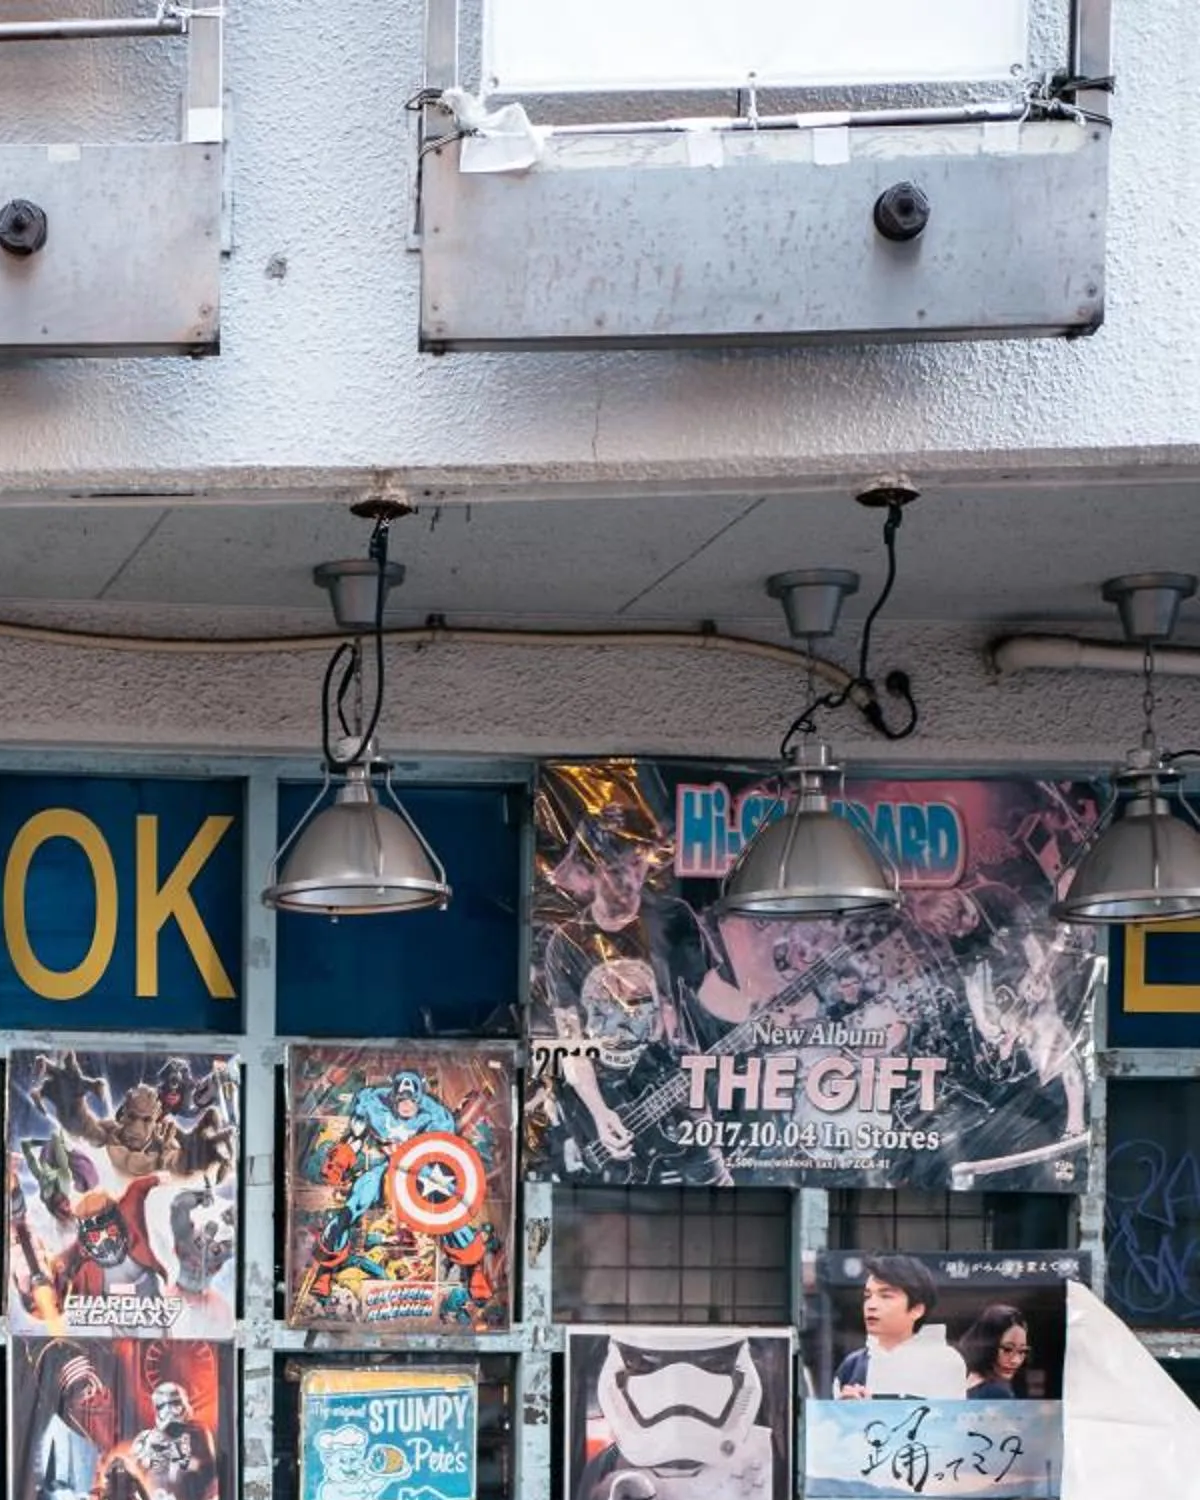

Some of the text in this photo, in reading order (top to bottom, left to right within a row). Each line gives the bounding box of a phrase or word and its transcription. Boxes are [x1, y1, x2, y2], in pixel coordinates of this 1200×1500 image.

[752, 1022, 886, 1046] New Album
[680, 1055, 948, 1112] THE GIFT
[677, 1121, 940, 1151] 2017.10.04 In Stores
[64, 1295, 184, 1311] GUARDIANS
[88, 1310, 180, 1327] GALAXY
[369, 1396, 468, 1434] STUMPY
[406, 1437, 468, 1473] Pete's
